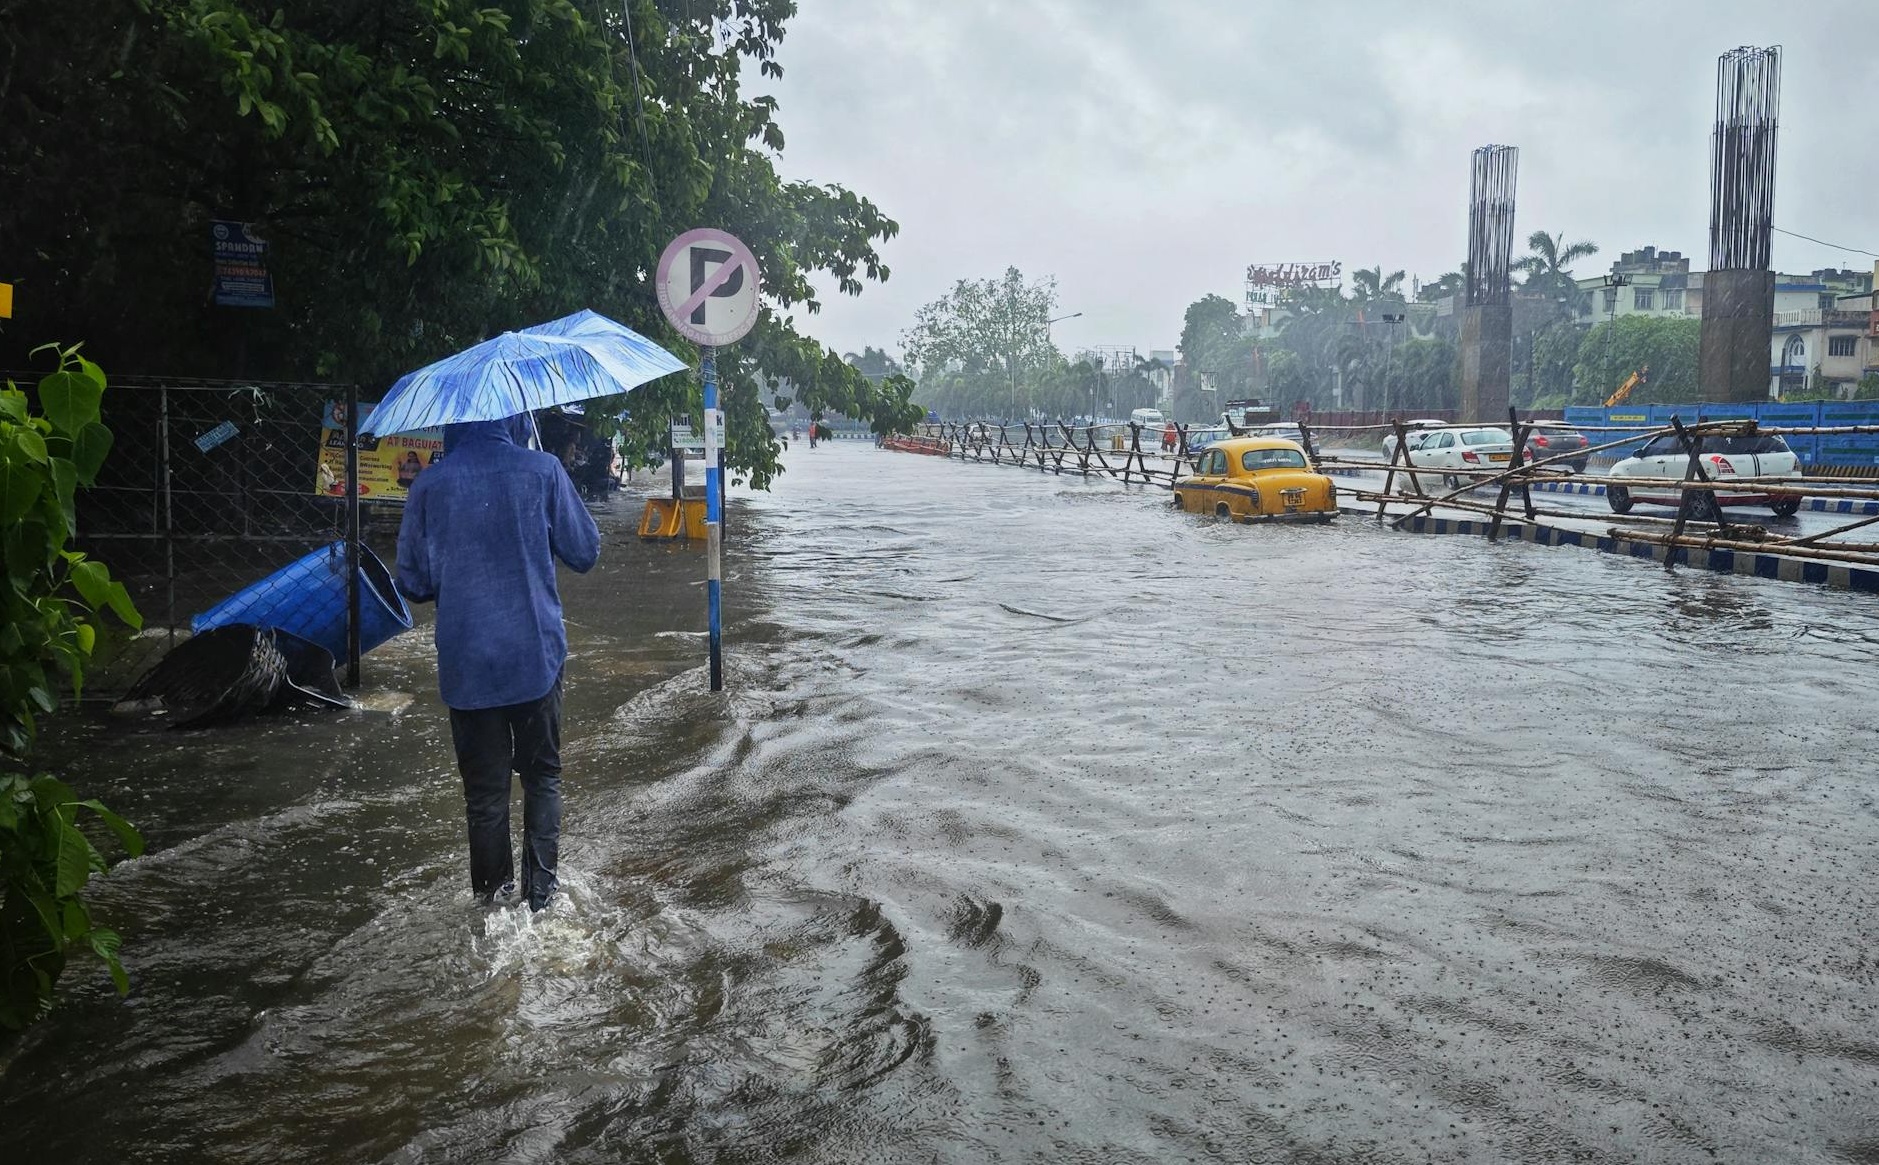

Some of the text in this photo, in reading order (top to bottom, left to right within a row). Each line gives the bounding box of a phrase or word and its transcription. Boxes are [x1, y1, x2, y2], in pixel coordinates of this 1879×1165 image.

[215, 241, 264, 253] SPANDAN
[690, 246, 744, 326] P
[386, 436, 443, 449] AT BAGUIAT
